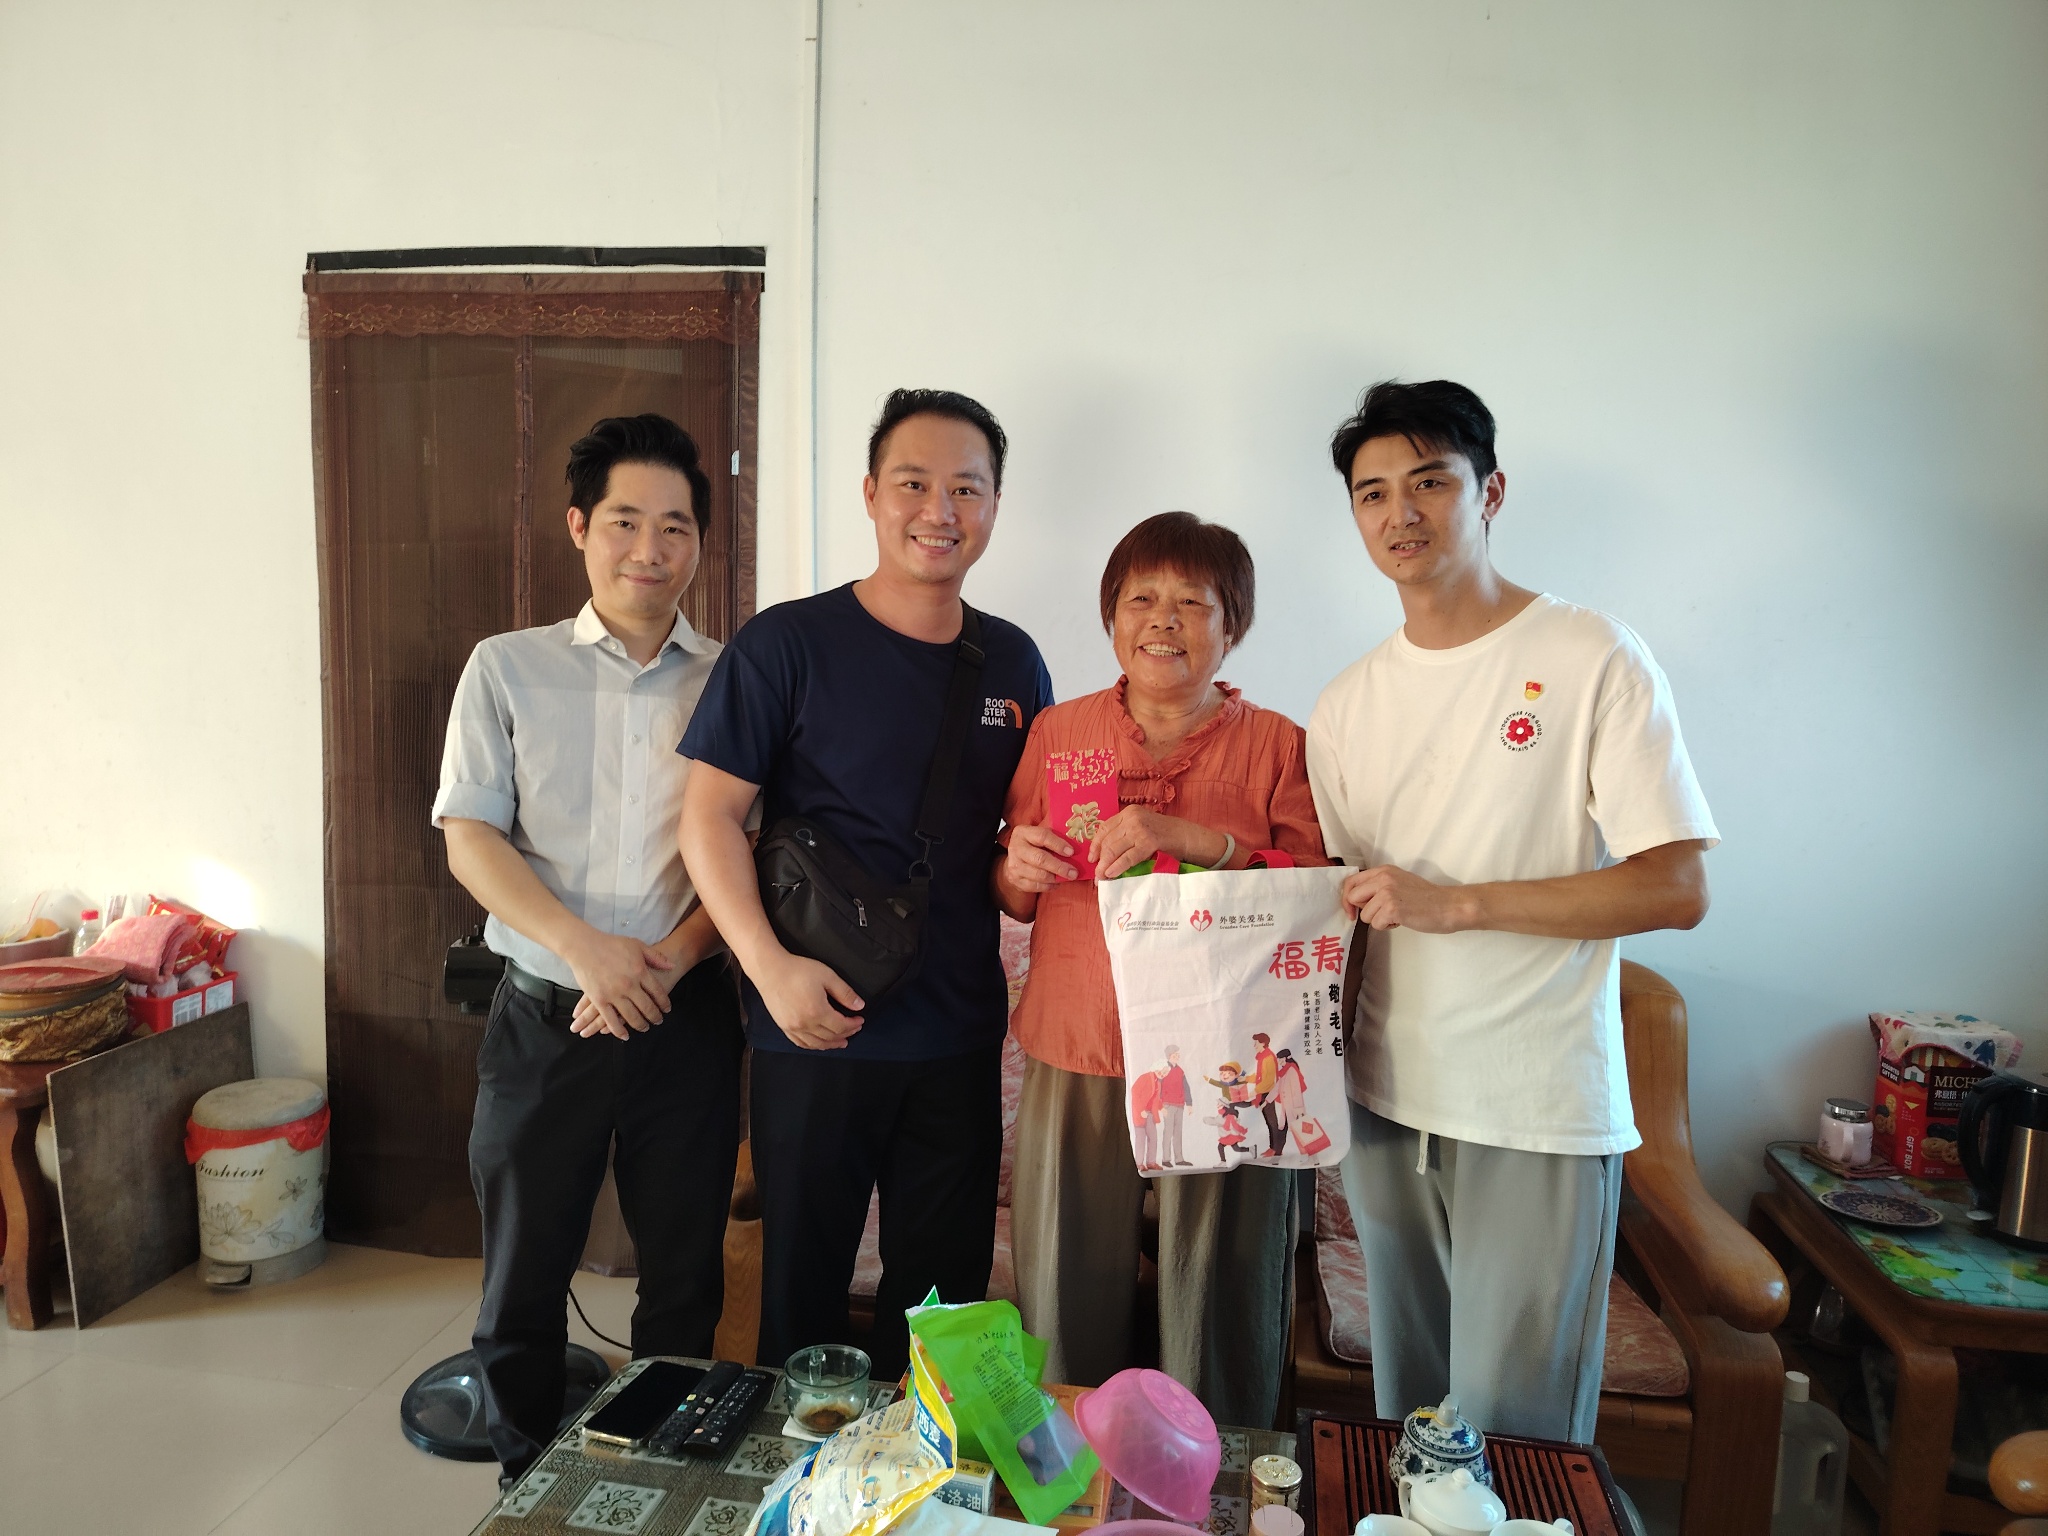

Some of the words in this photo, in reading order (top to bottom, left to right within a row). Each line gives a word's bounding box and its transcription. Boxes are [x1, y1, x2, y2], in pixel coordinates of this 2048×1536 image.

[985, 698, 1005, 708] ROO
[984, 708, 1006, 717] STER
[1525, 711, 1536, 720] FOR
[981, 716, 1007, 727] RUHL
[1220, 913, 1274, 924] 外婆关爱基金
[1268, 935, 1344, 980] 福寿
[1314, 990, 1323, 1054] 老吾老以及人之老
[1934, 1075, 1981, 1089] MICH
[1906, 1135, 1914, 1154] GIFT
[1904, 1154, 1913, 1170] BOX
